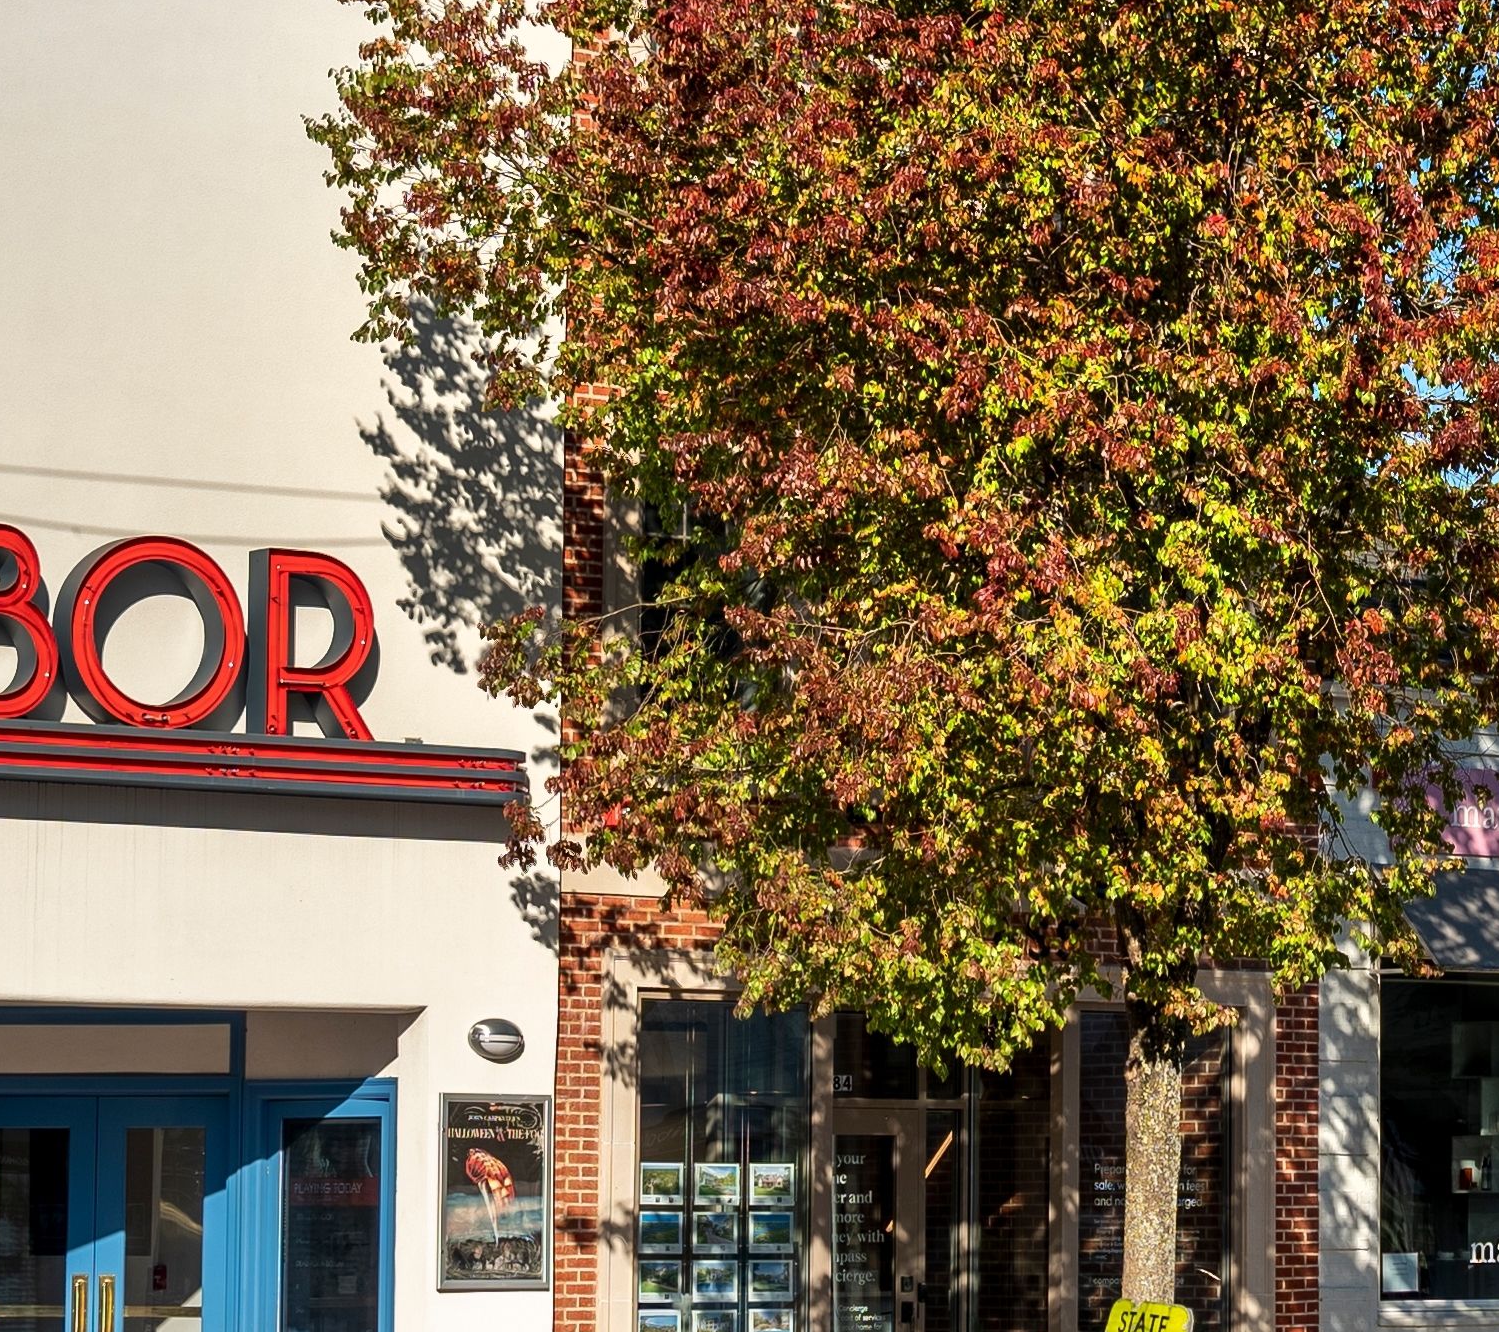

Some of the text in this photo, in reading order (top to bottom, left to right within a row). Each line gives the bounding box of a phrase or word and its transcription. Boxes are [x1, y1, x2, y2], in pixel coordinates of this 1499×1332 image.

[833, 1075, 852, 1092] 84
[447, 1127, 495, 1140] HALLOWEEN
[294, 1182, 363, 1195] PLAYING TODAY
[848, 1190, 873, 1204] and
[857, 1229, 885, 1244] with
